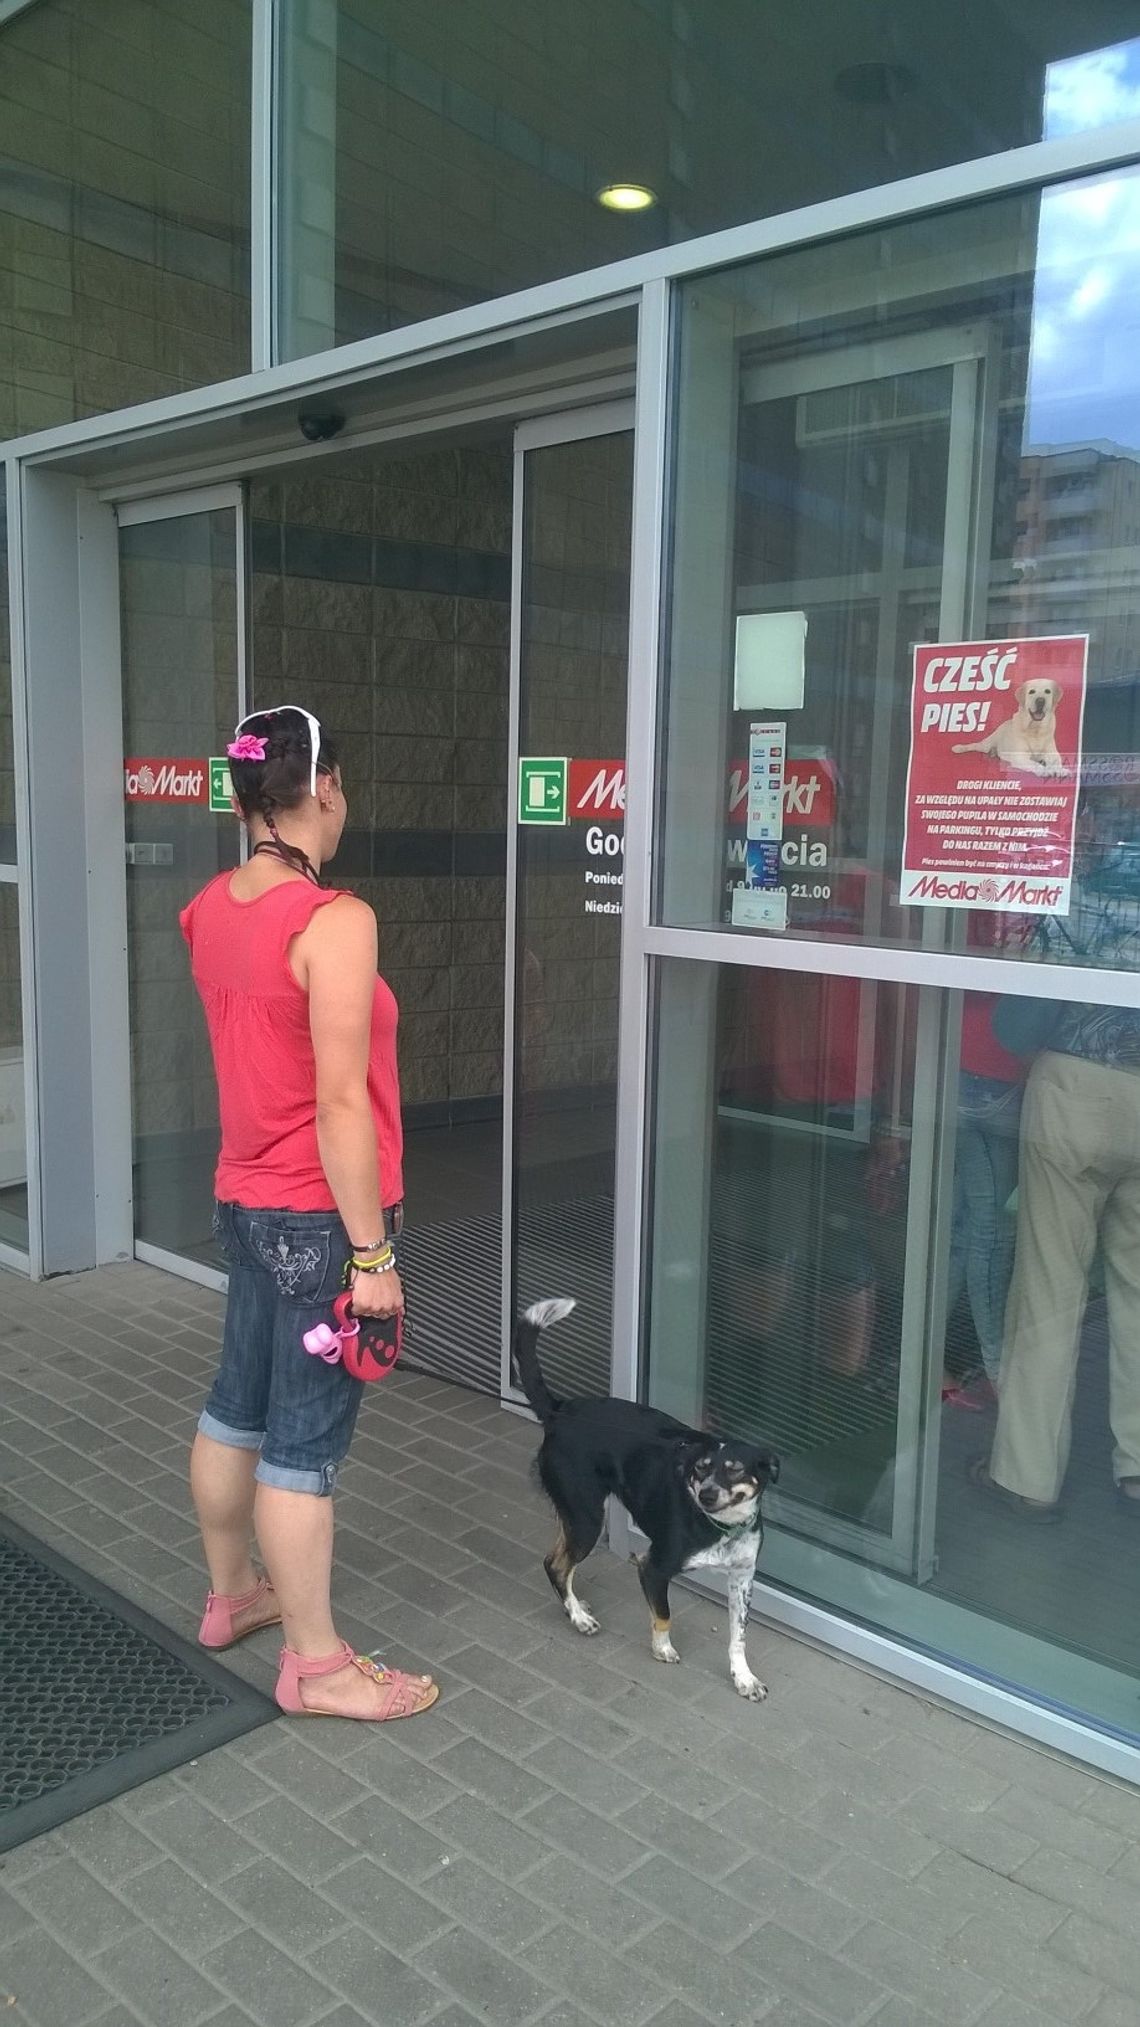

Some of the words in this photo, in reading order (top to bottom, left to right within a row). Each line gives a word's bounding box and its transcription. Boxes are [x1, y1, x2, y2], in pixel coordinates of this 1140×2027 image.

[923, 647, 1017, 693] CZEŚĆ
[921, 701, 991, 733] PIES!
[151, 765, 203, 796] Markt
[957, 780, 982, 790] DROGI
[982, 781, 1022, 791] KLIENCIE,
[915, 795, 926, 804] ZA
[926, 795, 963, 807] WZGLĘDU
[964, 796, 976, 805] NA
[976, 796, 1003, 806] UPAŁY
[1003, 796, 1019, 806] NIE
[1019, 796, 1067, 808] ZOSTAWIAJ
[921, 810, 957, 821] SWOJEGO
[957, 810, 987, 821] PUPILA
[987, 811, 997, 821] W
[997, 811, 1060, 822] SAMOCHODZIE
[927, 824, 940, 834] NA
[940, 825, 983, 836] PARKINGU,
[984, 826, 1010, 837] TYLKO
[942, 839, 955, 850] DO
[955, 840, 972, 850] NAS
[972, 841, 1001, 851] RAZEM
[1001, 842, 1008, 851] Z
[791, 883, 831, 899] 21.00
[908, 875, 980, 902] Media
[994, 880, 1063, 906] Markt
